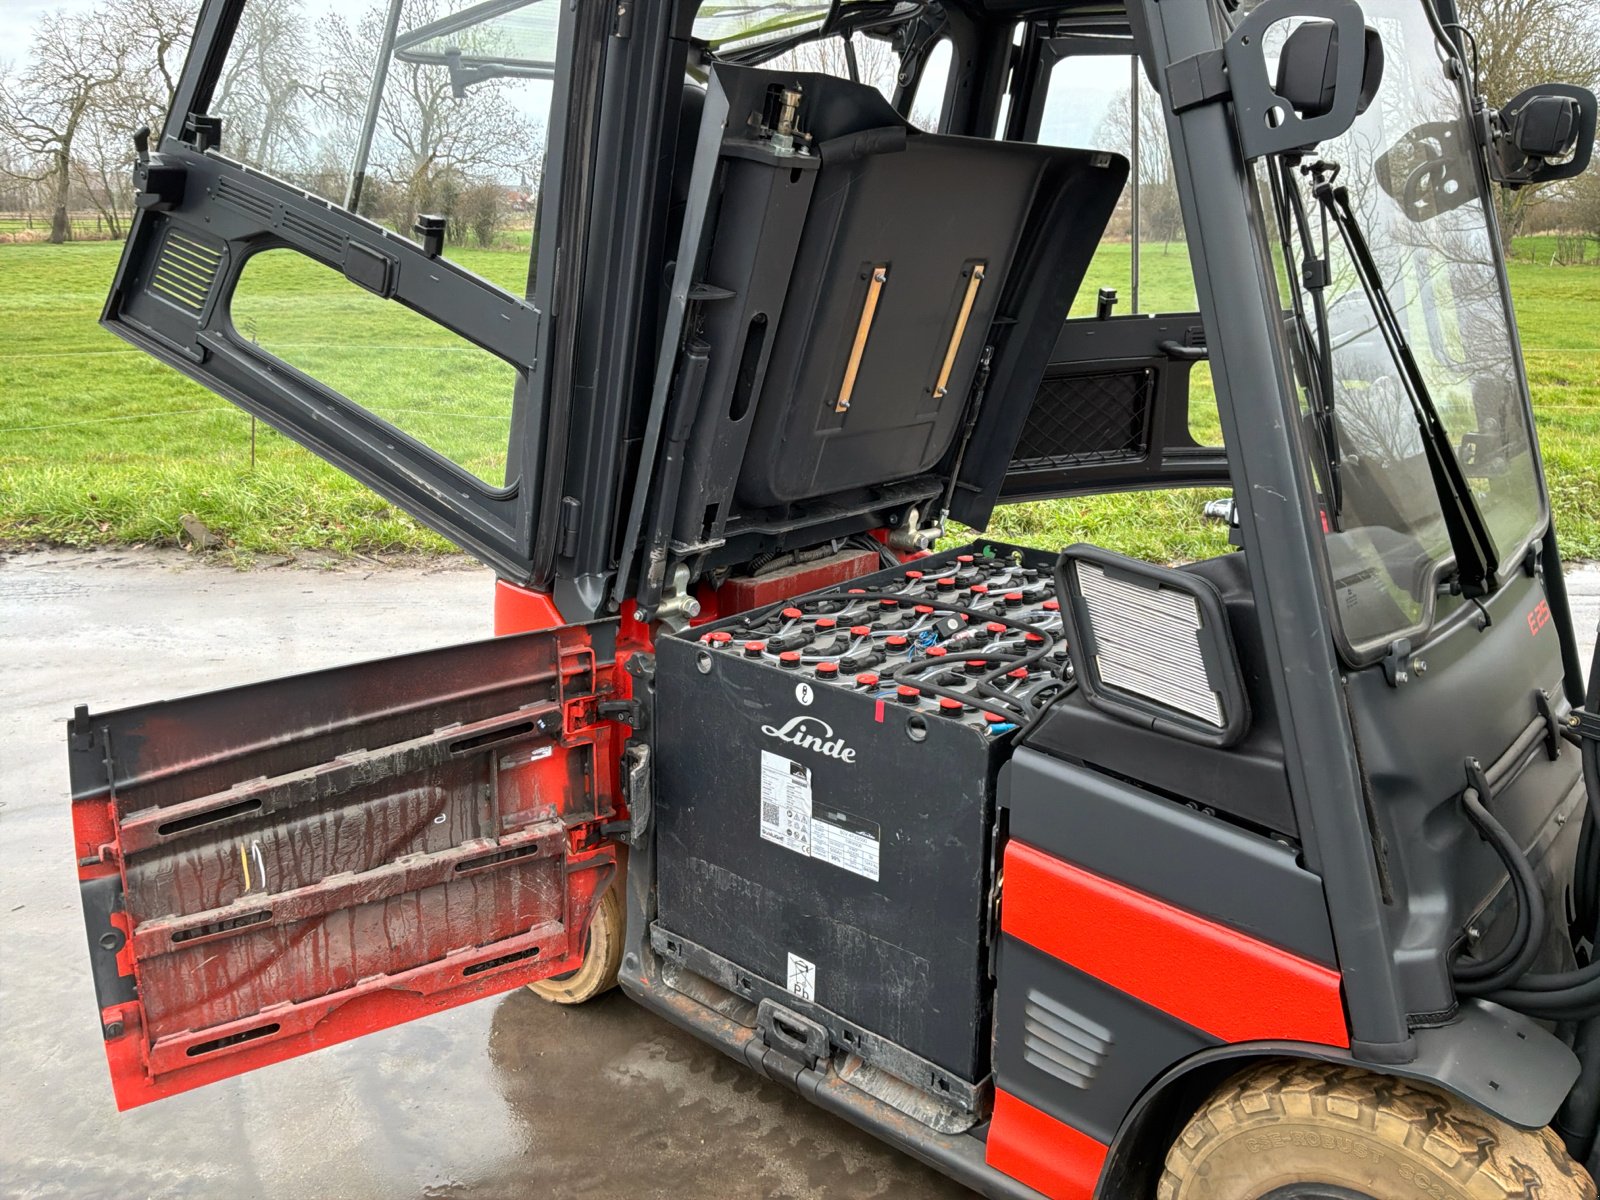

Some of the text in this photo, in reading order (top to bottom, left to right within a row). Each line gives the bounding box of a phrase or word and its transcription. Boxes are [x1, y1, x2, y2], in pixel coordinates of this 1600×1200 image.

[1527, 599, 1550, 636] E25
[761, 715, 856, 764] Linde
[793, 984, 809, 1000] Pb
